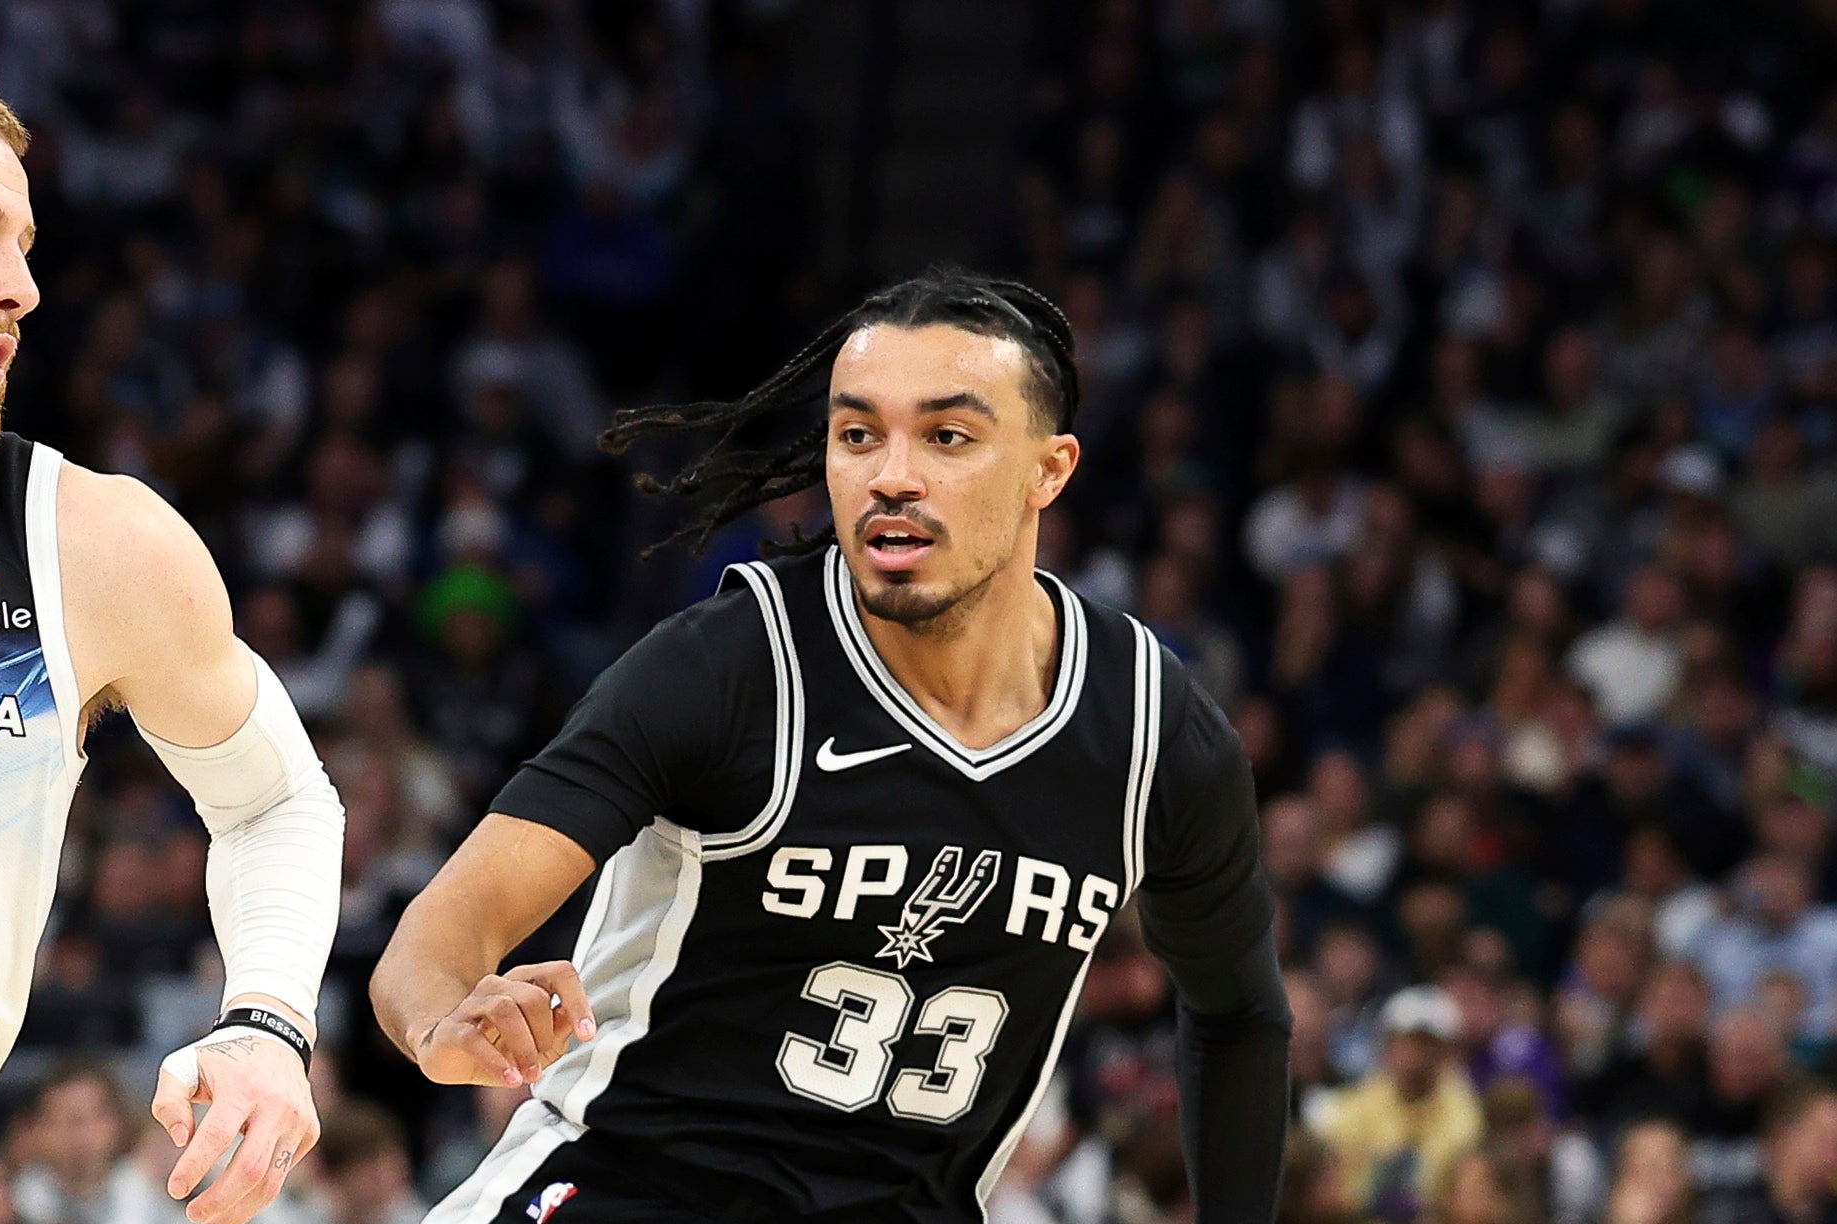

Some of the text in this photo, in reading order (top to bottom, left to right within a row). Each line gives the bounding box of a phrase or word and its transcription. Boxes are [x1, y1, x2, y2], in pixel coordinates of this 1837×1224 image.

[762, 844, 1119, 968] SPURS
[249, 1010, 304, 1049] Blessed
[774, 960, 1010, 1125] 33
